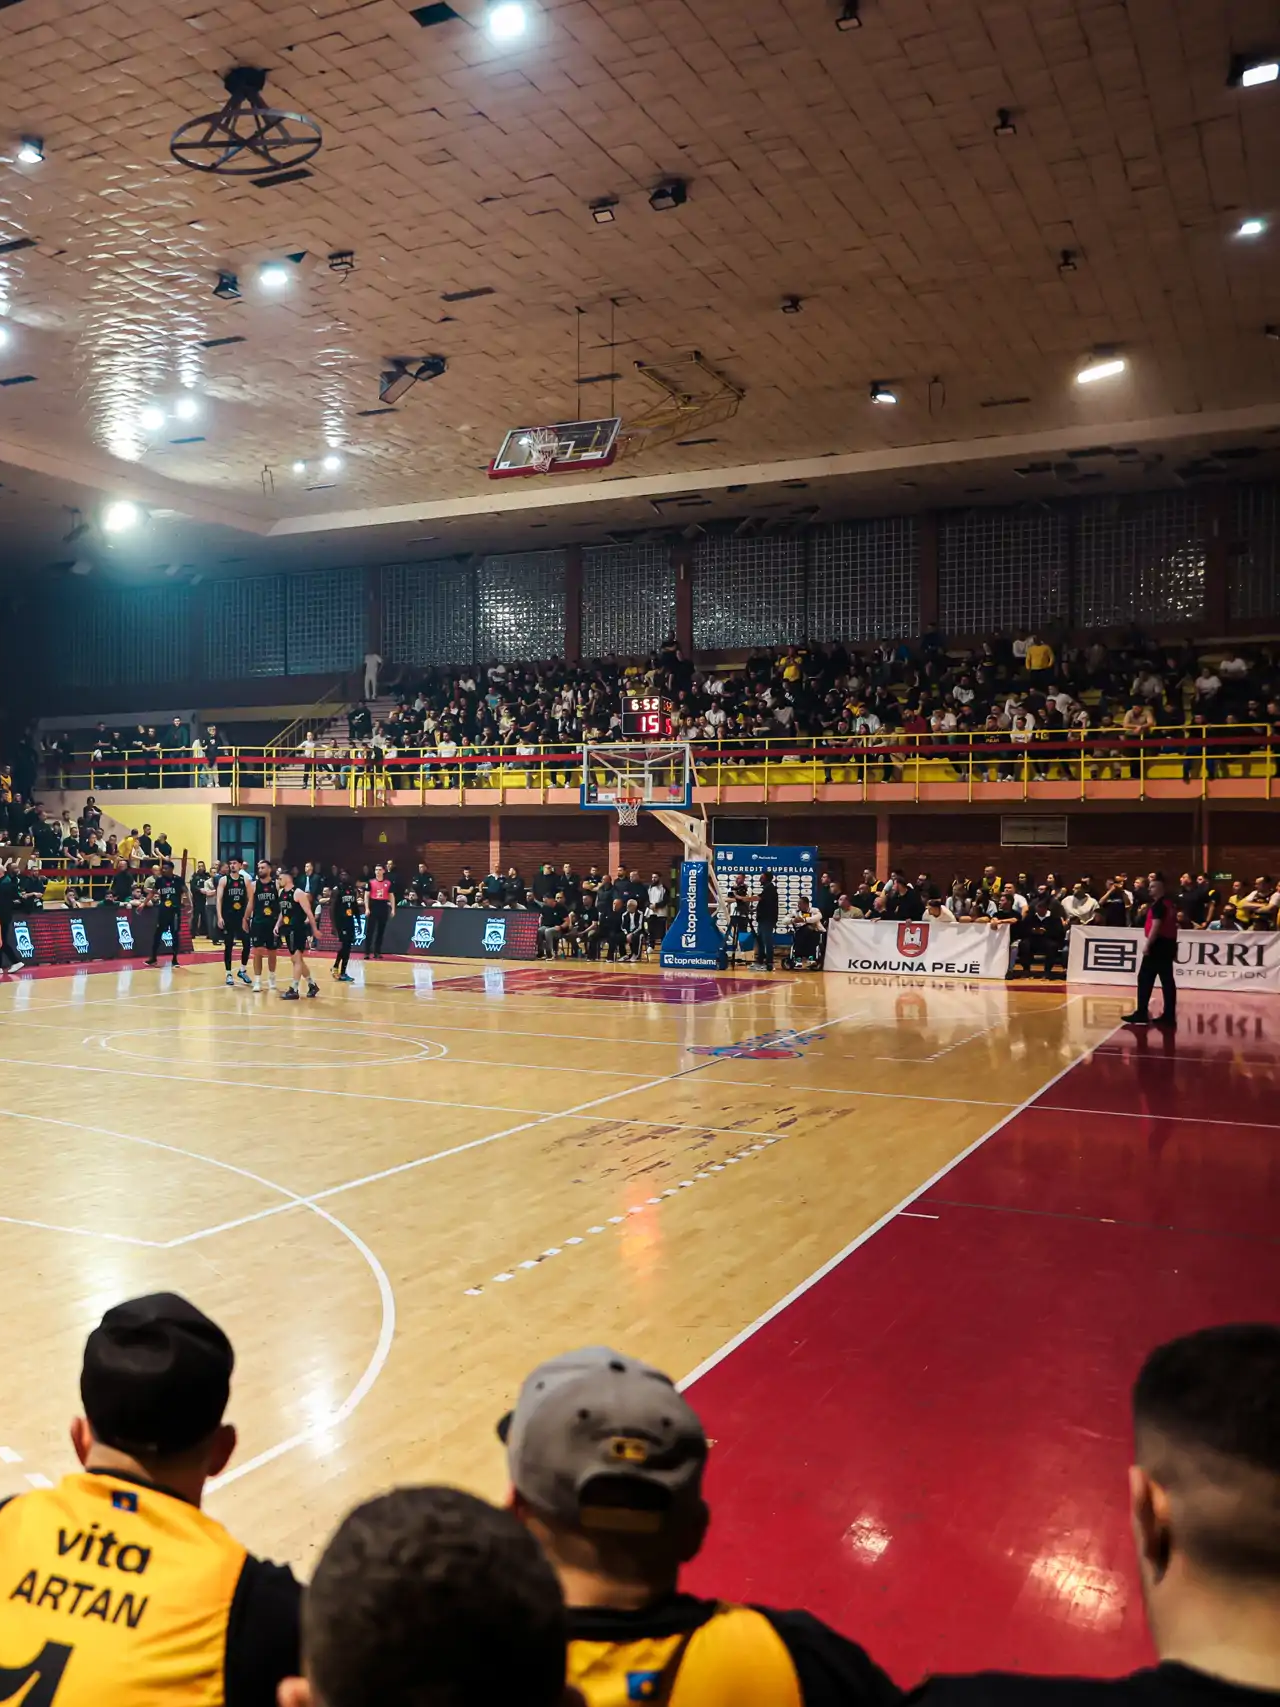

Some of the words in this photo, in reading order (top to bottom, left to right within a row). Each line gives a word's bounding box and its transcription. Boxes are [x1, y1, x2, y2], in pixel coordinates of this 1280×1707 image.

[631, 698, 659, 711] 6:52
[642, 715, 659, 734] 15
[686, 869, 698, 933] topreklama
[1175, 941, 1267, 967] URRI
[848, 959, 927, 973] KOMUNA
[932, 960, 981, 974] PEJË
[1175, 967, 1267, 979] STRUCTION
[56, 1523, 152, 1575] vita
[10, 1569, 149, 1629] ARTAN
